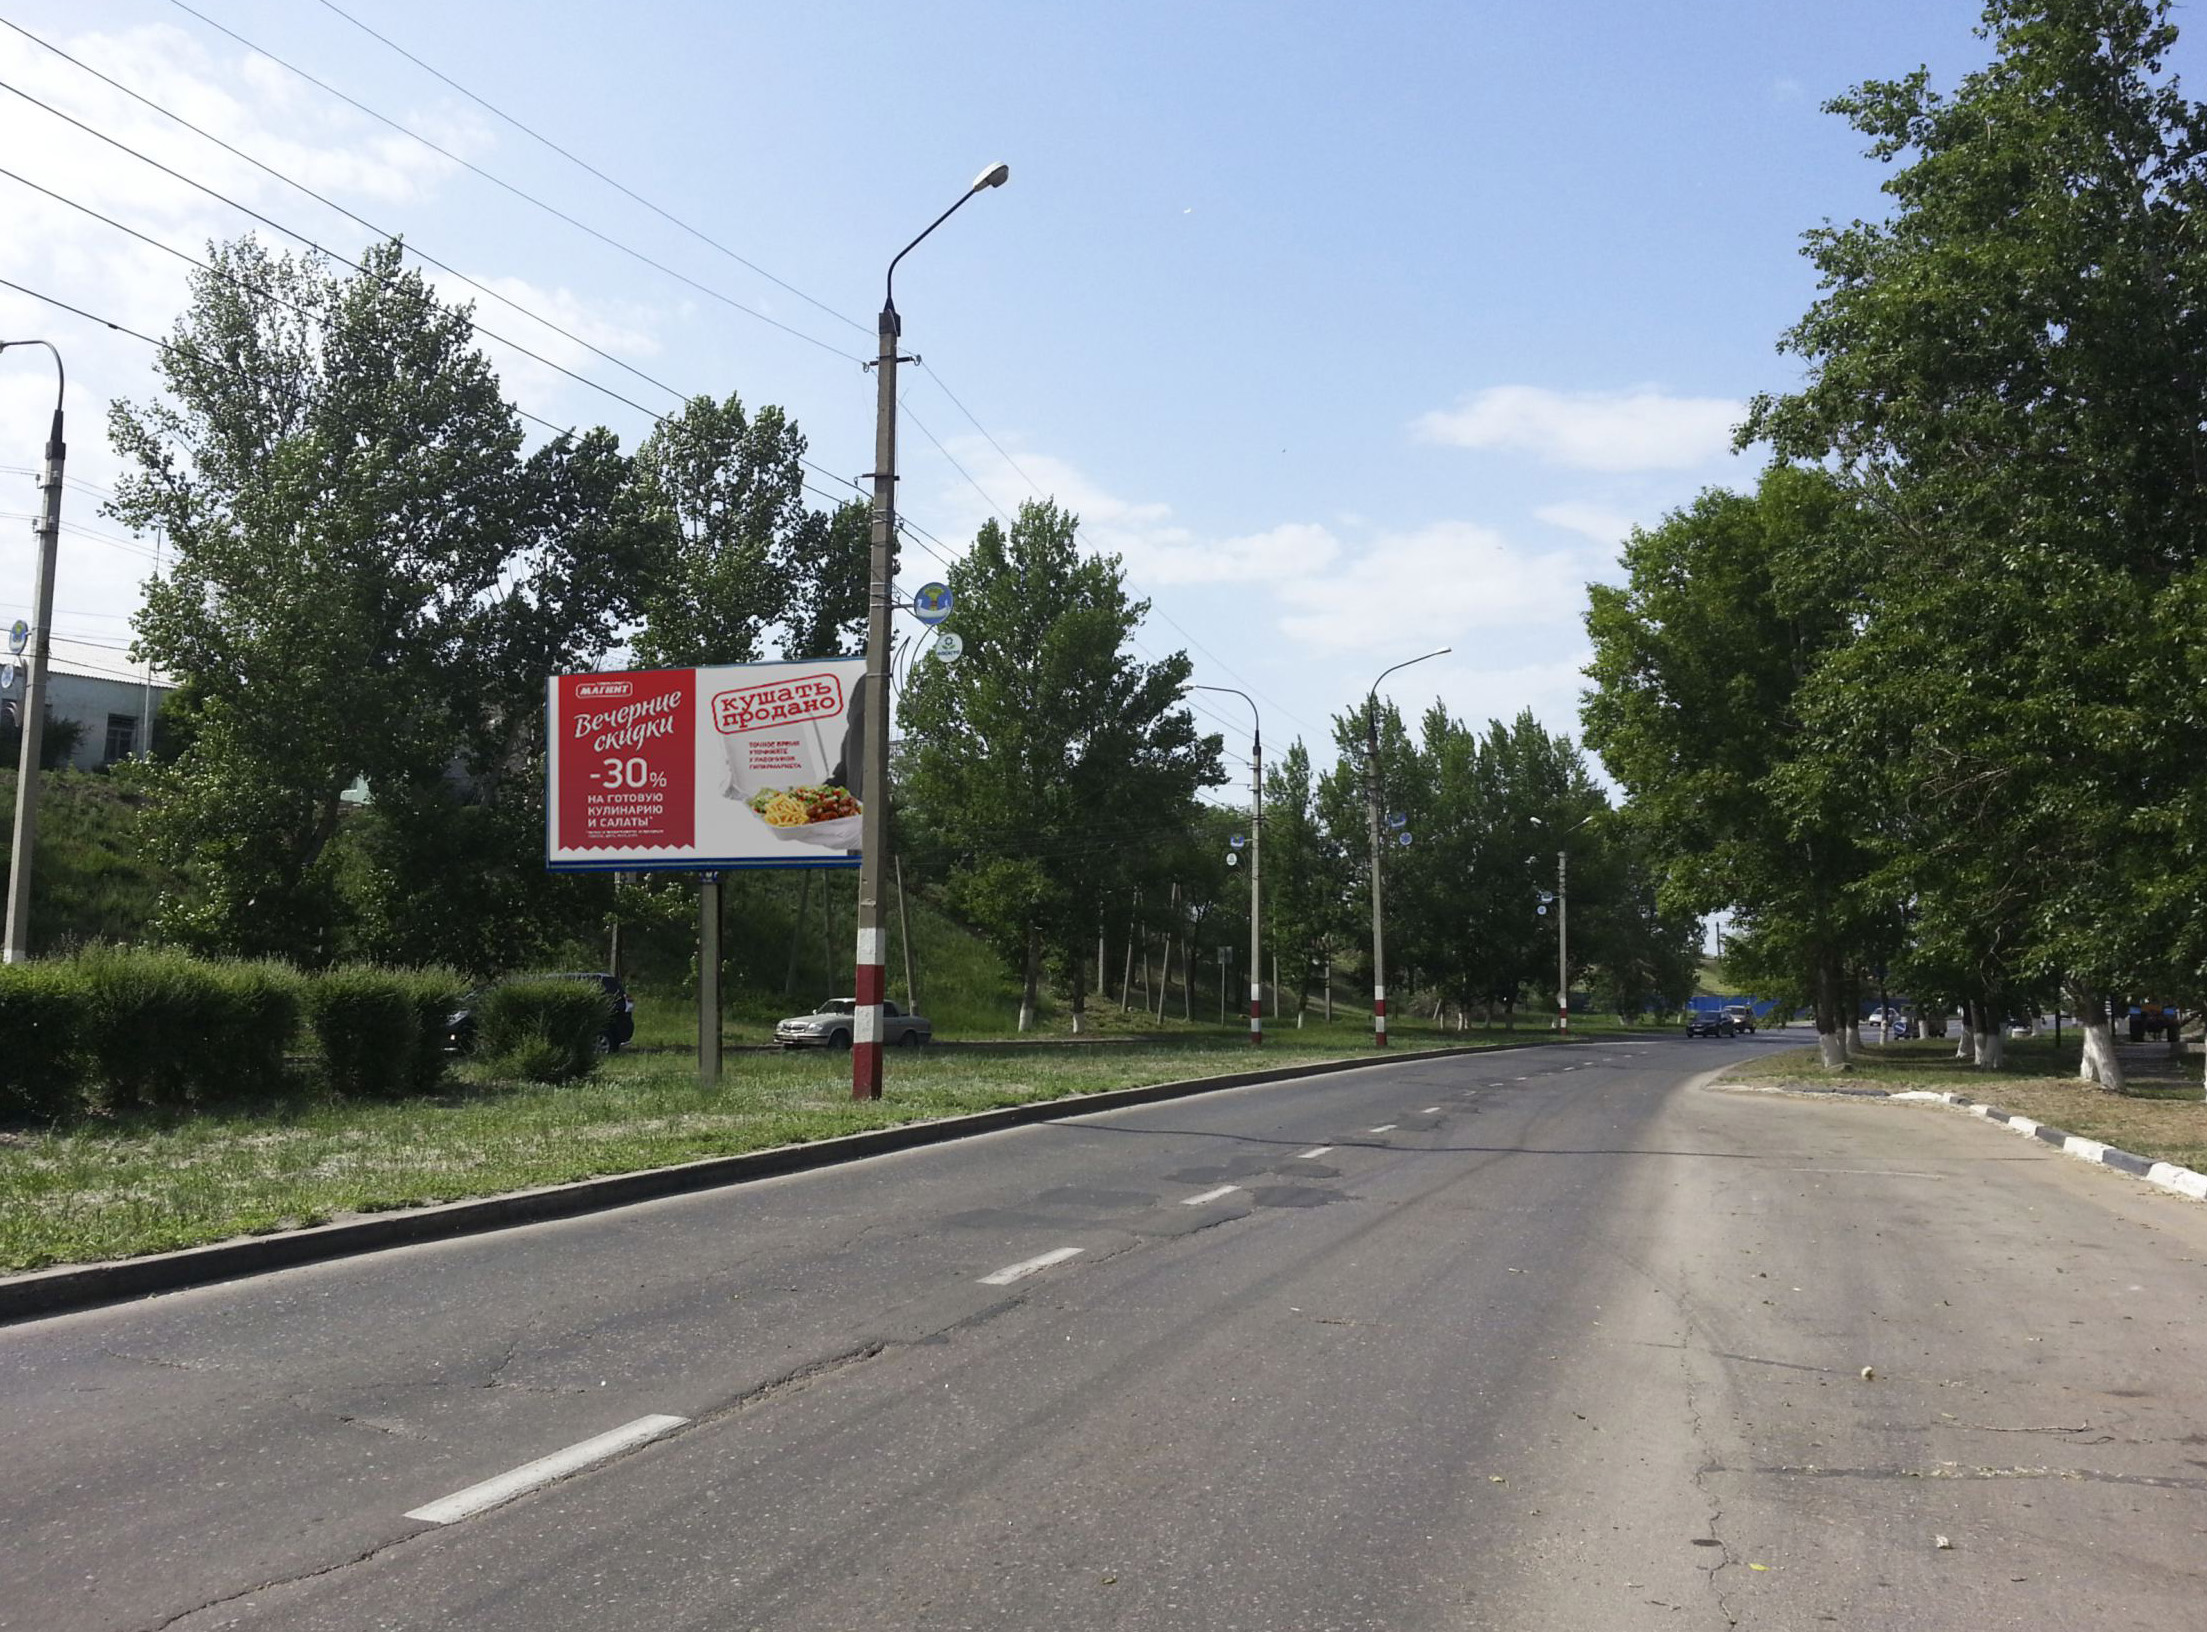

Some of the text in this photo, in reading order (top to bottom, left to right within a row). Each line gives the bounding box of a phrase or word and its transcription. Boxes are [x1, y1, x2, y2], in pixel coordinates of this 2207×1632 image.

[580, 685, 629, 695] МАГНИТ
[721, 683, 832, 712] кушать
[574, 691, 682, 738] Вечерние
[723, 697, 836, 728] продано
[594, 715, 674, 751] скидки
[588, 793, 663, 804] НА ГОТОВУЮ
[588, 805, 663, 816] КУЛИНАРИЮ
[588, 819, 597, 828] И
